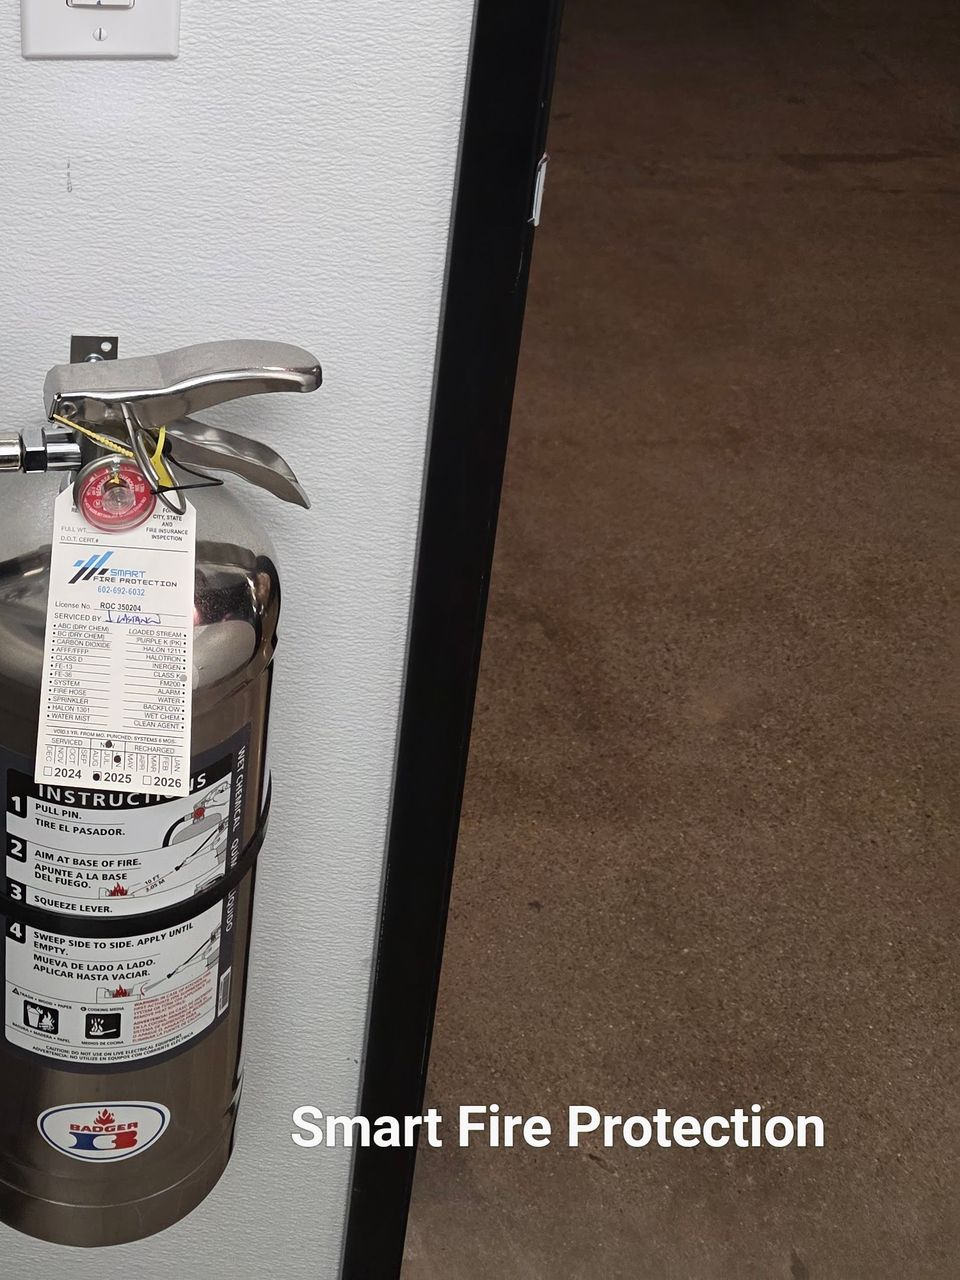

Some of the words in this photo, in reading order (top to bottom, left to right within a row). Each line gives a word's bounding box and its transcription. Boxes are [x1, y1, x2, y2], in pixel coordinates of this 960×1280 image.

[152, 534, 182, 542] INSPECTION
[110, 568, 146, 578] SMART
[98, 586, 146, 596] 602-692-6032
[119, 578, 178, 588] PROTECTION
[54, 601, 80, 609] License
[81, 602, 91, 610] No.
[100, 602, 116, 610] ROC
[118, 603, 142, 612] 350204
[54, 612, 90, 622] SERVICED
[236, 745, 246, 772] WET
[54, 767, 82, 780] 2024
[104, 772, 132, 784] 2025
[154, 776, 182, 788] 2026
[11, 796, 20, 812] 1
[35, 802, 59, 816] PULL
[62, 810, 82, 820] PIN.
[233, 774, 244, 832] CHEMICAL
[35, 818, 56, 830] TIRE
[58, 824, 70, 832] EL
[72, 826, 126, 836] PASADOR.
[10, 840, 22, 858] 2
[34, 850, 54, 860] AIM
[57, 856, 70, 864] AT
[72, 859, 98, 867] BASE
[101, 860, 114, 868] OF
[117, 858, 142, 867] FIRE.
[34, 863, 73, 878] APUNTE
[76, 872, 84, 880] A
[86, 872, 98, 880] LA
[34, 872, 52, 882] DEL
[55, 878, 92, 888] FUEGO.
[10, 883, 22, 900] 3
[34, 895, 76, 911] SQUEEZE
[80, 904, 112, 913] LEVER.
[10, 922, 22, 938] 4
[34, 931, 66, 945] SWEEP
[68, 940, 91, 948] SIDE
[109, 940, 134, 949] SIDE.
[136, 932, 166, 946] APPLY
[169, 922, 194, 938] UNTIL
[34, 941, 68, 956] EMPTY.
[34, 954, 68, 968] MUEVA
[71, 962, 84, 970] DE
[126, 958, 156, 970] LADO.
[33, 964, 74, 979] APLICAR
[76, 972, 109, 981] HASTA
[112, 970, 150, 981] VACIAR.
[70, 1121, 138, 1133] BADGER
